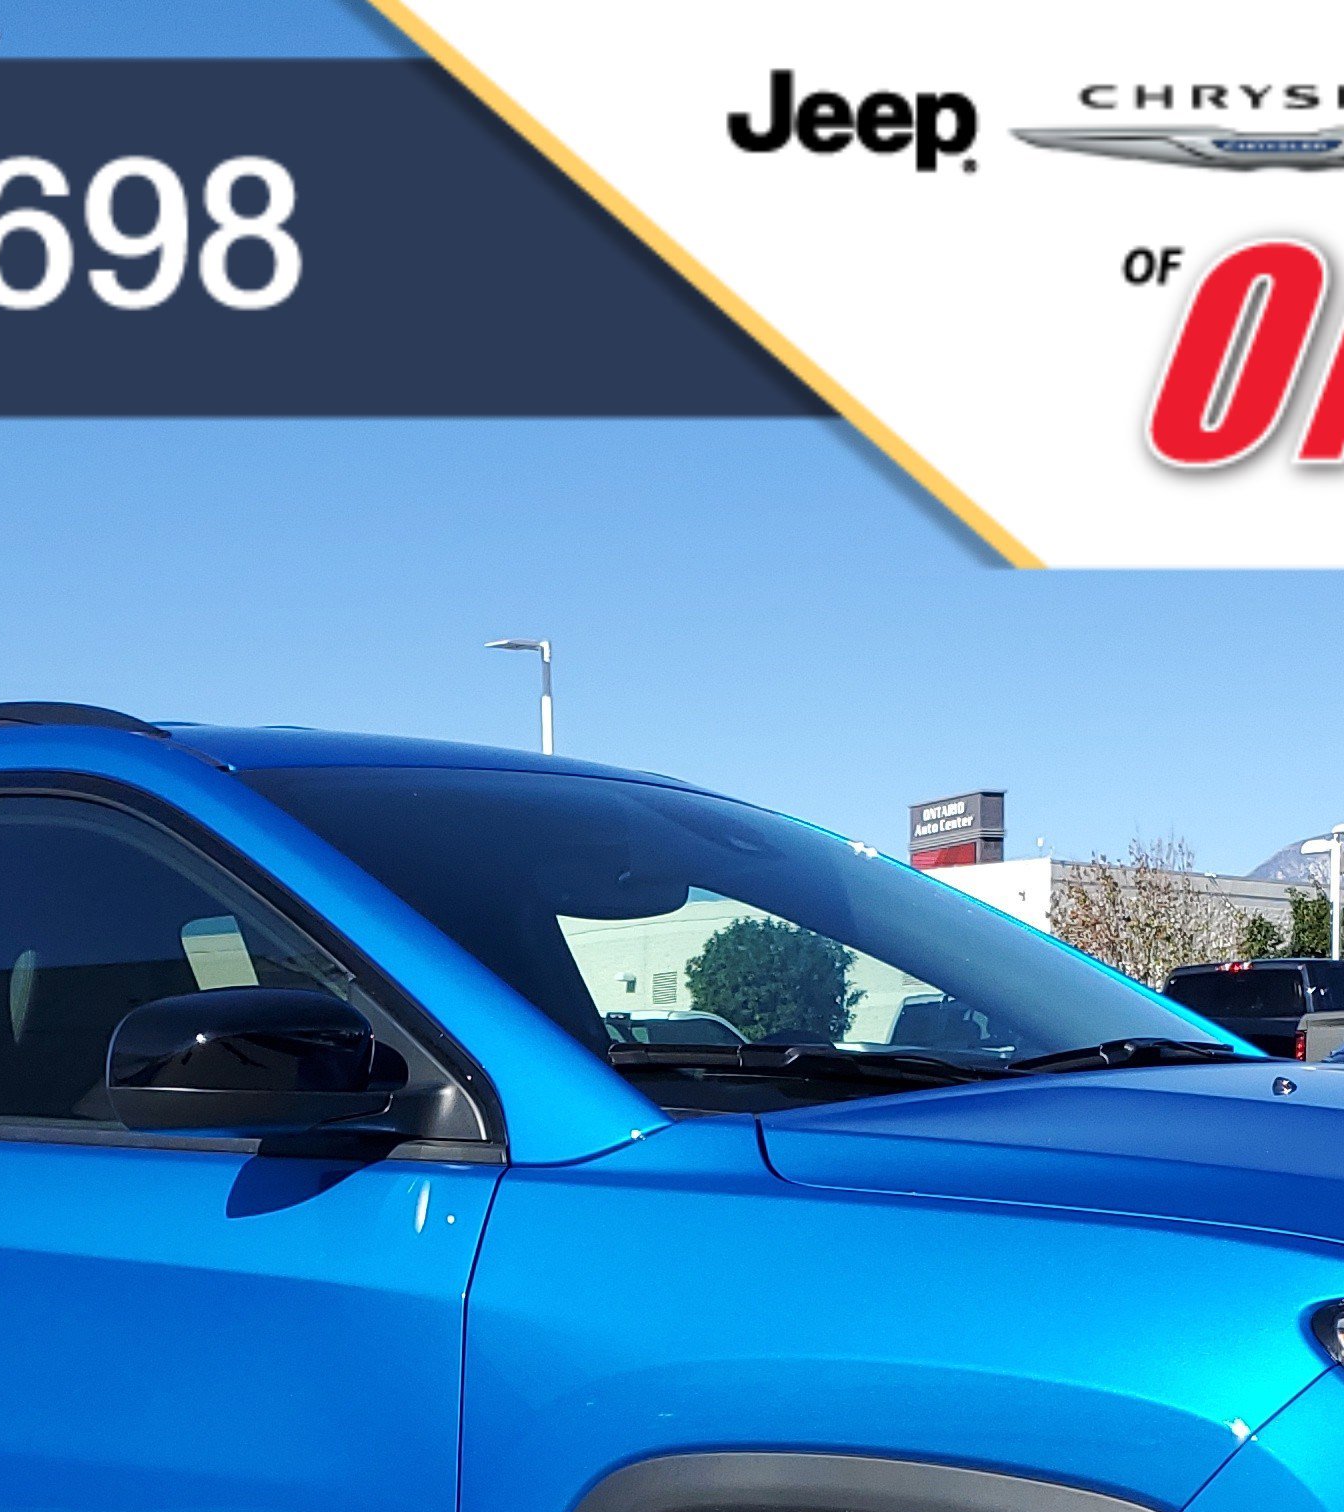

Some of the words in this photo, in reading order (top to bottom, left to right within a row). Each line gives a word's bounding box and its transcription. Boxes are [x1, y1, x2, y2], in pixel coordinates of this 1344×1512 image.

[922, 801, 965, 821] ONTARIO
[914, 823, 939, 837] Auto
[939, 815, 974, 832] Center
